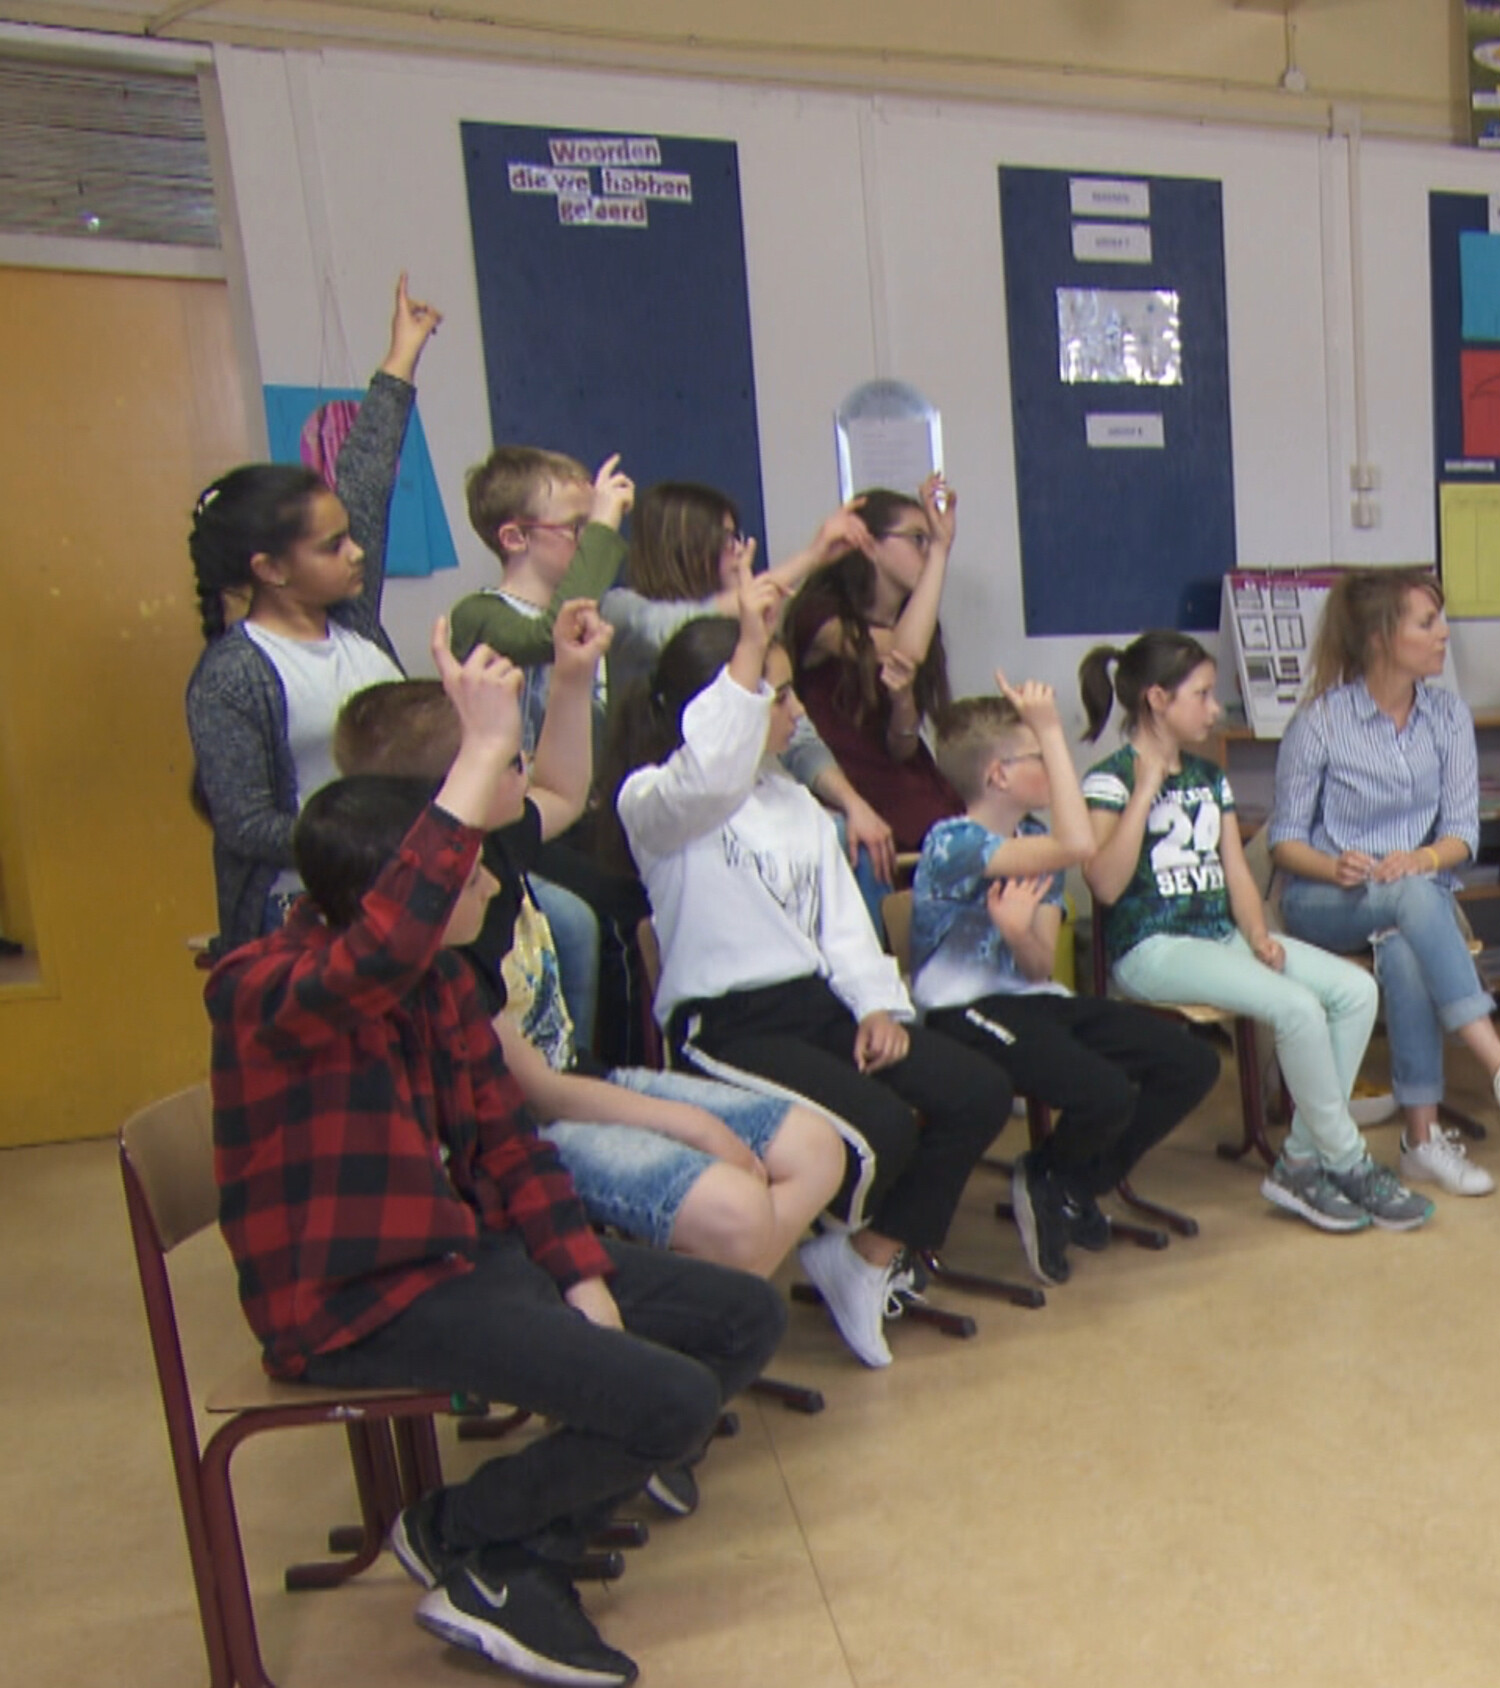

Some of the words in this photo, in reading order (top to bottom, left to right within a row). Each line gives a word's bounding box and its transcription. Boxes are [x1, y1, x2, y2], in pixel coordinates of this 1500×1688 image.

[552, 141, 658, 163] Woorden
[511, 167, 547, 189] die
[555, 174, 590, 192] we
